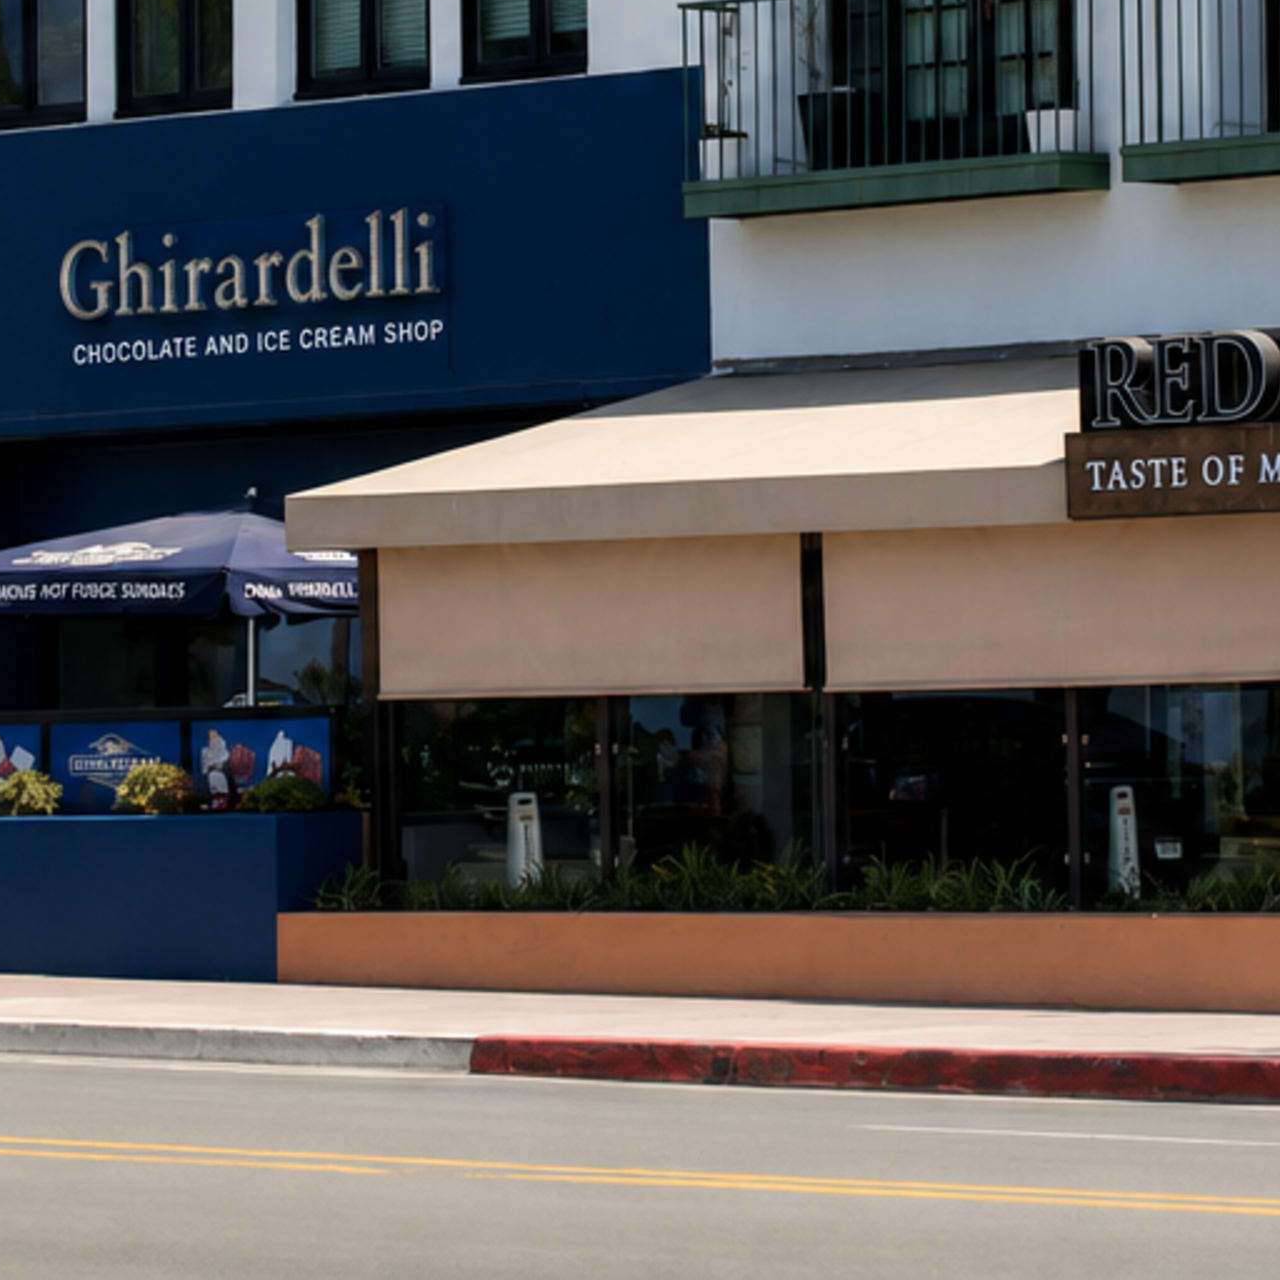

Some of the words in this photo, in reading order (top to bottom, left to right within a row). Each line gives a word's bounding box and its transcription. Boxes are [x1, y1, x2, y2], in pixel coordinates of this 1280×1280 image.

[59, 208, 441, 321] Ghirardelli
[73, 336, 197, 366] CHOCOLATE
[204, 333, 249, 356] AND
[257, 330, 292, 353] ICE
[299, 324, 376, 349] CREAM
[383, 319, 444, 345] SHOP
[1085, 457, 1188, 491] TASTE
[1202, 454, 1245, 486] OF
